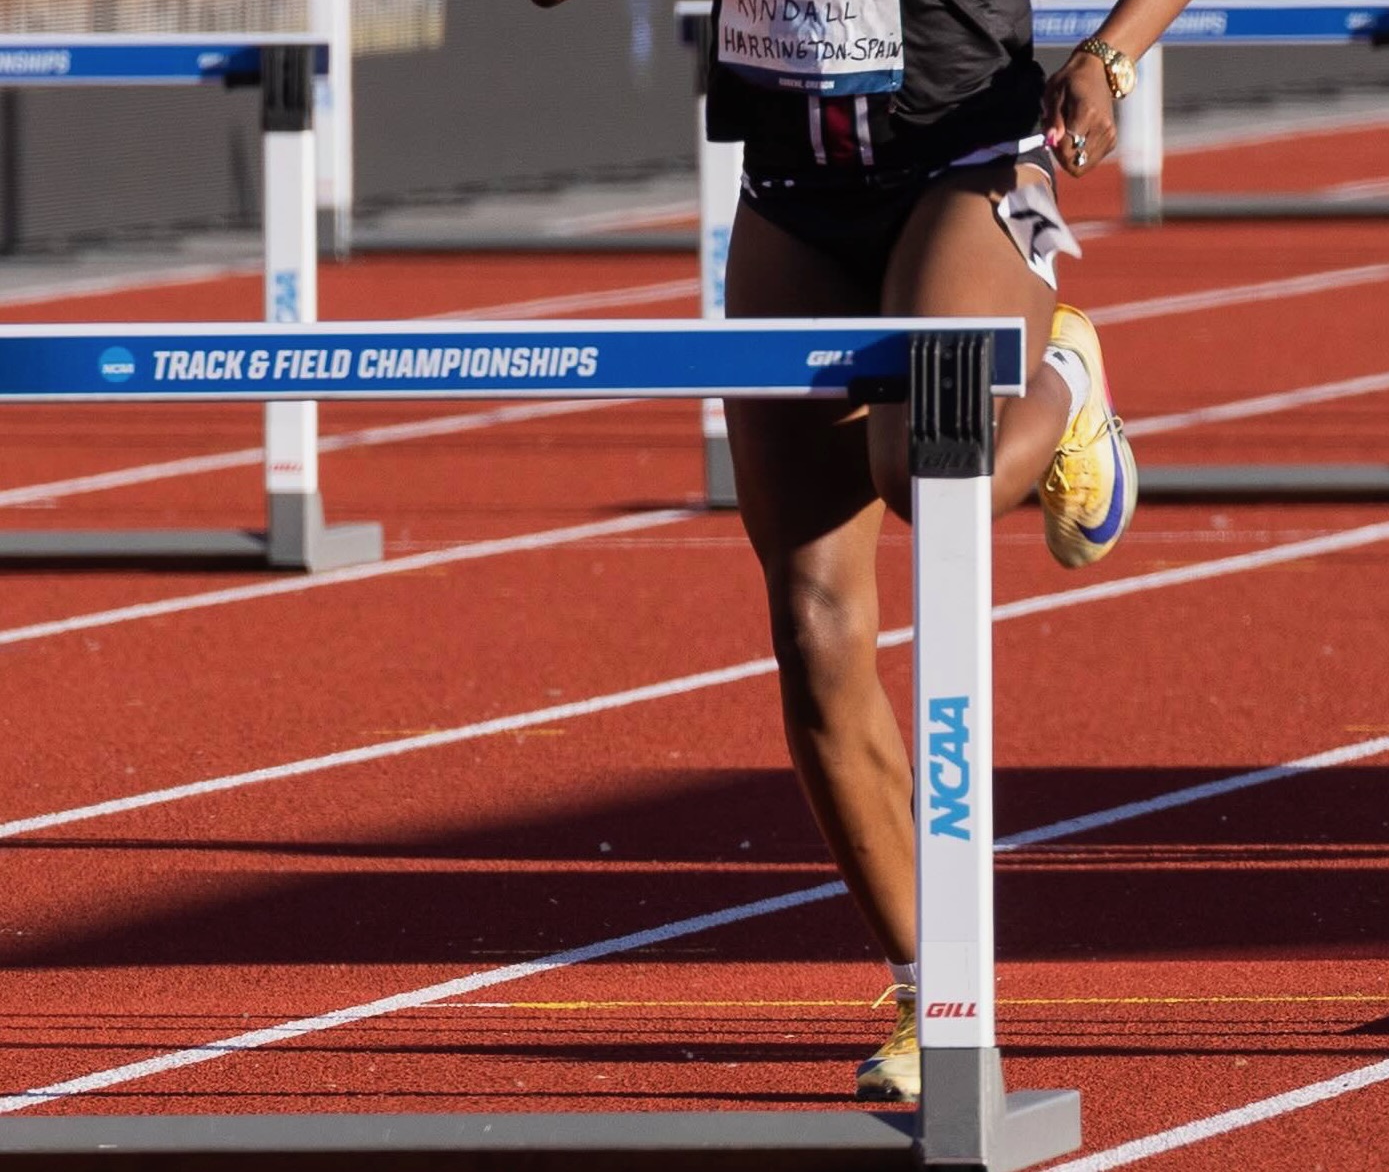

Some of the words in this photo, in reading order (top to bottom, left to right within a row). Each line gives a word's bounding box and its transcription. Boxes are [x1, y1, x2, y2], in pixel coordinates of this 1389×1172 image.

[153, 350, 245, 380] TRACK
[247, 350, 270, 380] &
[273, 349, 352, 380] FIELD
[357, 347, 599, 378] CHAMPIONSHIPS
[806, 350, 854, 366] GILL
[929, 696, 970, 841] NCAA
[925, 1002, 979, 1018] GILL
